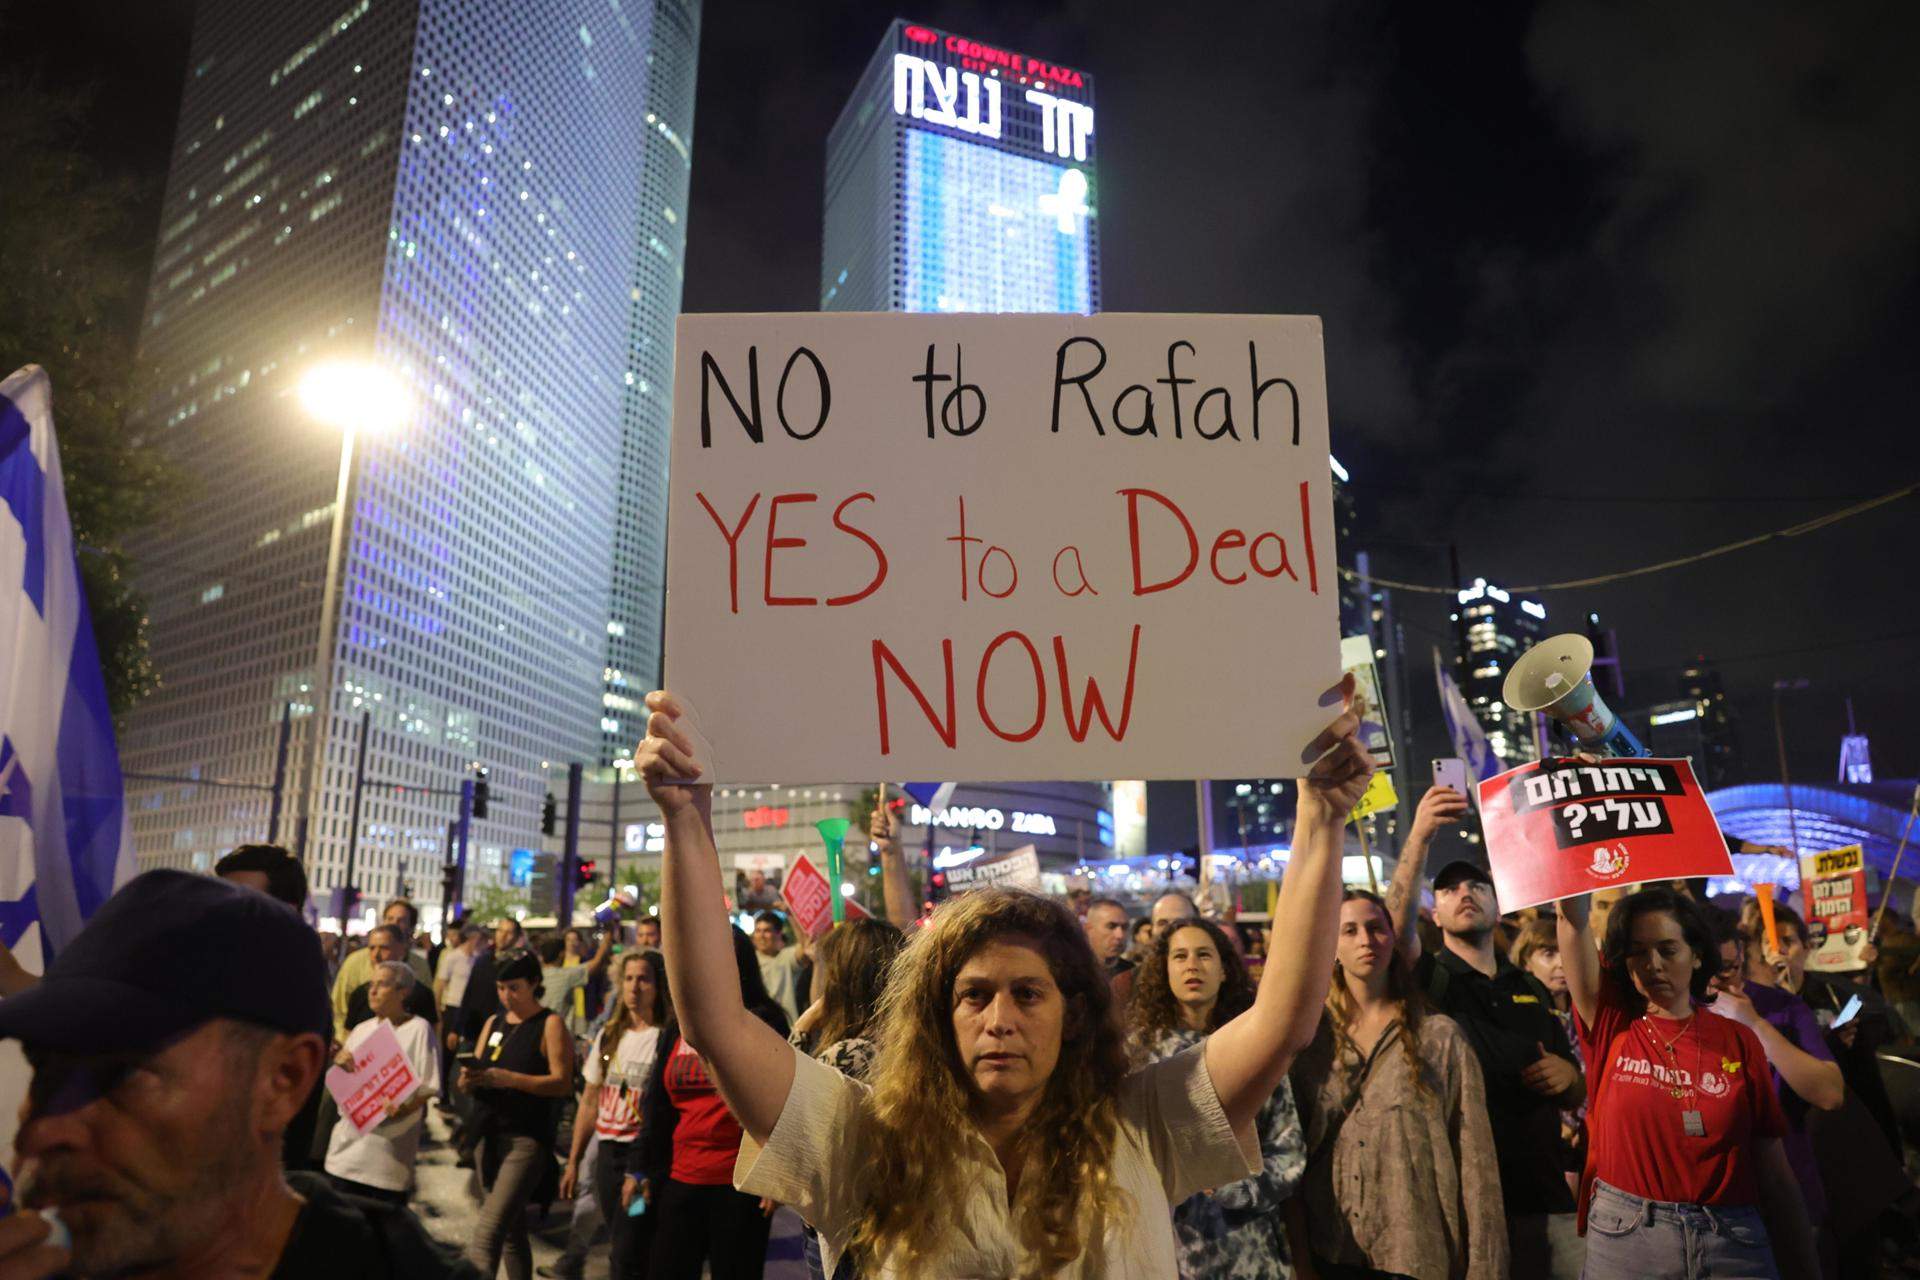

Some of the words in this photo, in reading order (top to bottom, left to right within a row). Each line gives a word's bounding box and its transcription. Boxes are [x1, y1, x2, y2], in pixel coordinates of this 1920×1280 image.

[893, 53, 1001, 139] ננצח
[945, 36, 1022, 72] CROWNE
[1027, 58, 1083, 88] PLAZA
[1025, 89, 1094, 162] יחד
[701, 346, 831, 447] NO
[1051, 336, 1300, 445] Rafah
[696, 492, 888, 614] YES
[947, 495, 1018, 601] to
[1053, 546, 1098, 596] a
[1117, 481, 1318, 595] Deal
[872, 624, 1141, 755] NOW
[911, 804, 1004, 830] MANGO
[1011, 811, 1056, 835] ZARA
[1524, 767, 1666, 806] ויתרתם
[1563, 798, 1662, 838] עלי?
